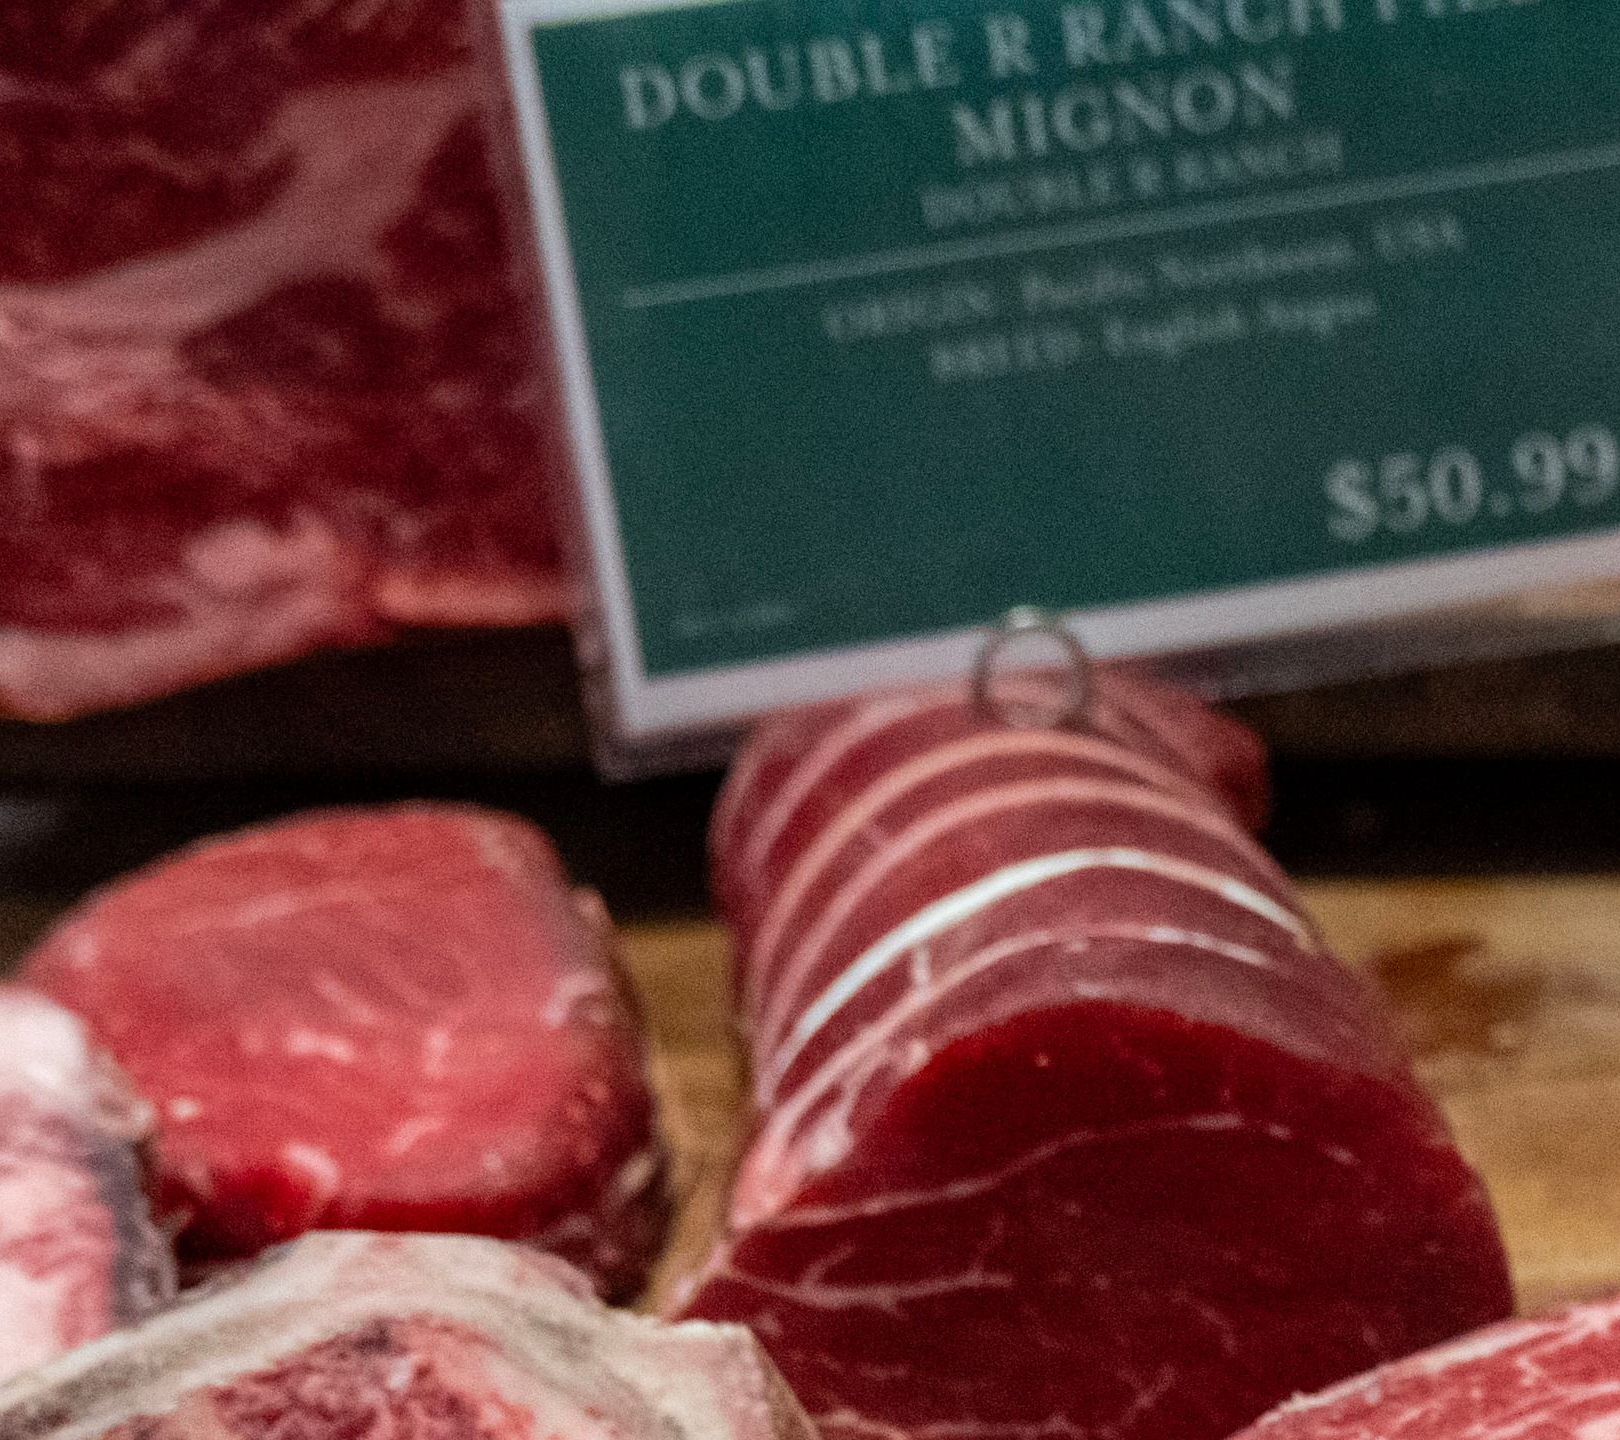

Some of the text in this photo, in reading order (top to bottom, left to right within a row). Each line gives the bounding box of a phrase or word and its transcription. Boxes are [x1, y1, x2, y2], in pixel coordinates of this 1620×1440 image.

[620, 21, 961, 131] DOUBLE
[986, 10, 1036, 79] R
[953, 54, 1295, 166] MIGNON
[1325, 423, 1620, 544] $50.99
